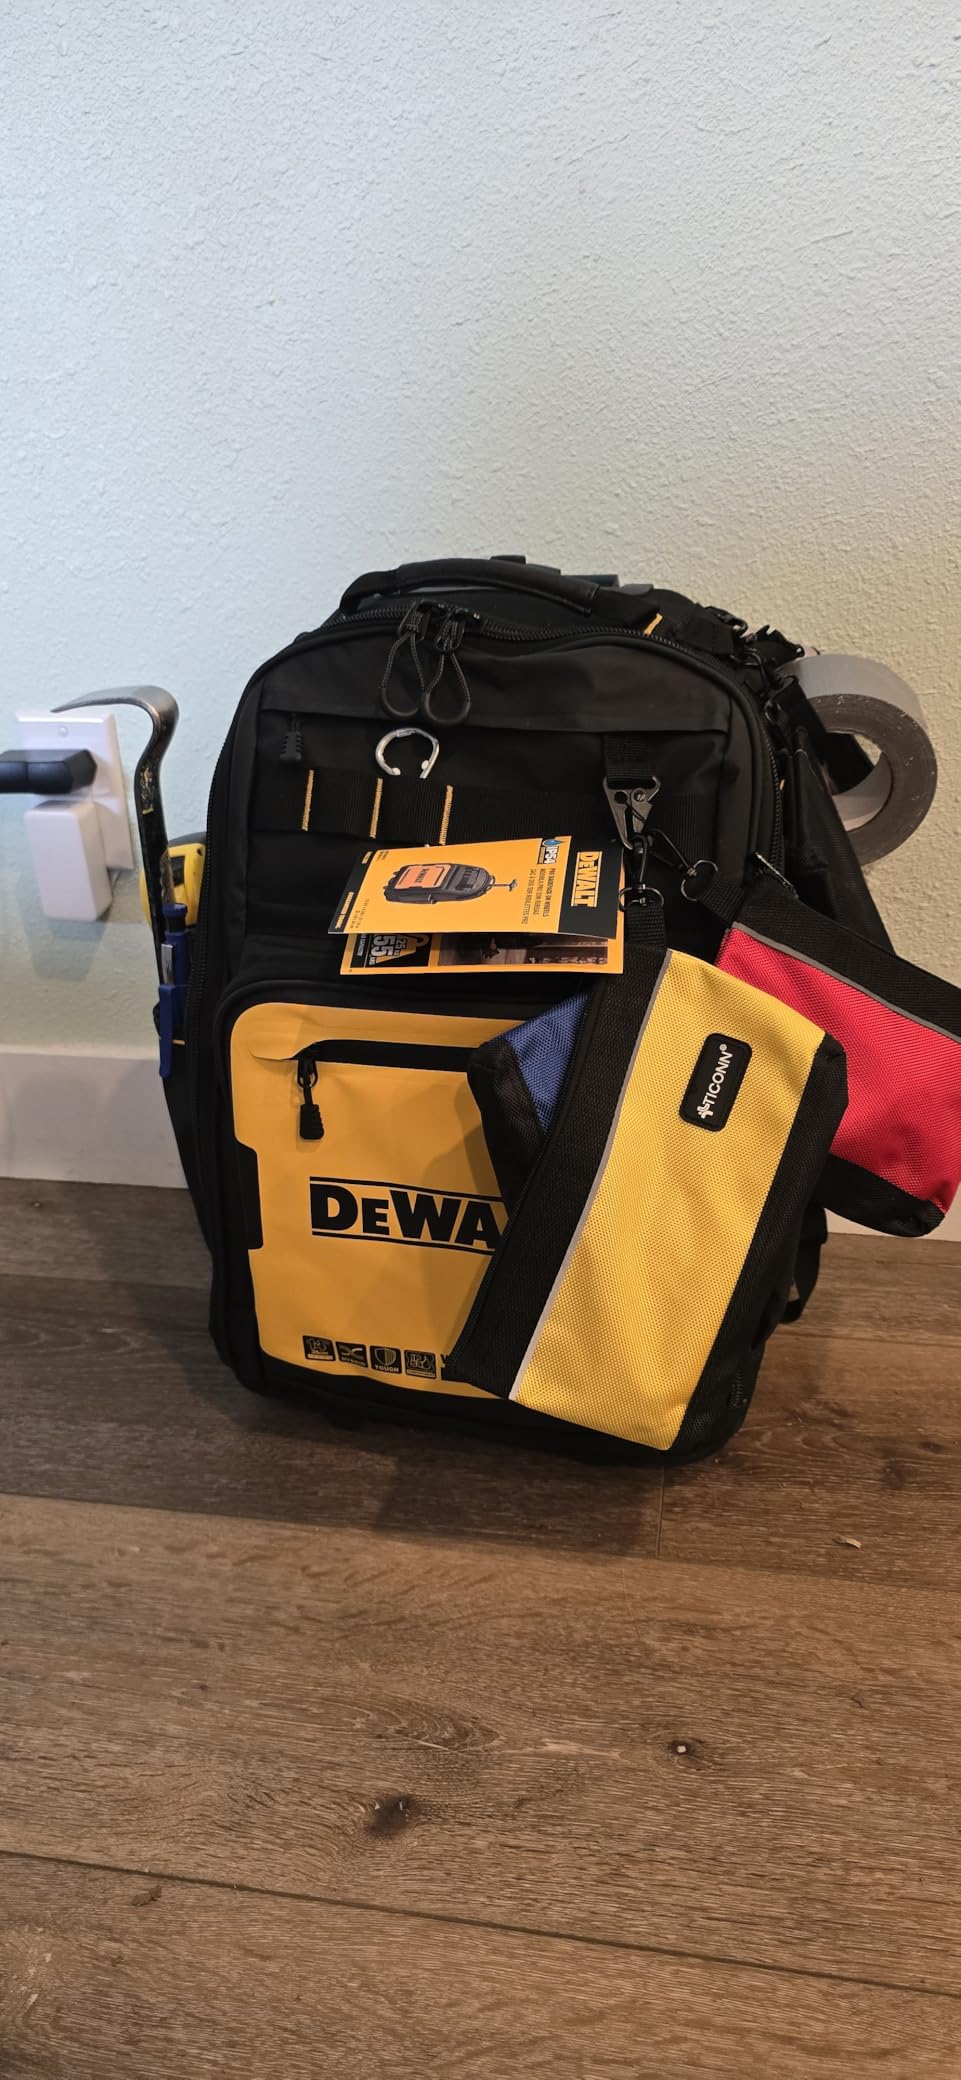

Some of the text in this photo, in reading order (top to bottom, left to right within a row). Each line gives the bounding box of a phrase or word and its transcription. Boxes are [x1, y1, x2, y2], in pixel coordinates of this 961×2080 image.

[544, 846, 558, 864] IP54
[573, 851, 601, 907] DEWALT
[370, 936, 396, 957] 55
[396, 938, 406, 950] 25
[310, 1183, 504, 1249] DEWA
[374, 1364, 400, 1373] TOUGH
